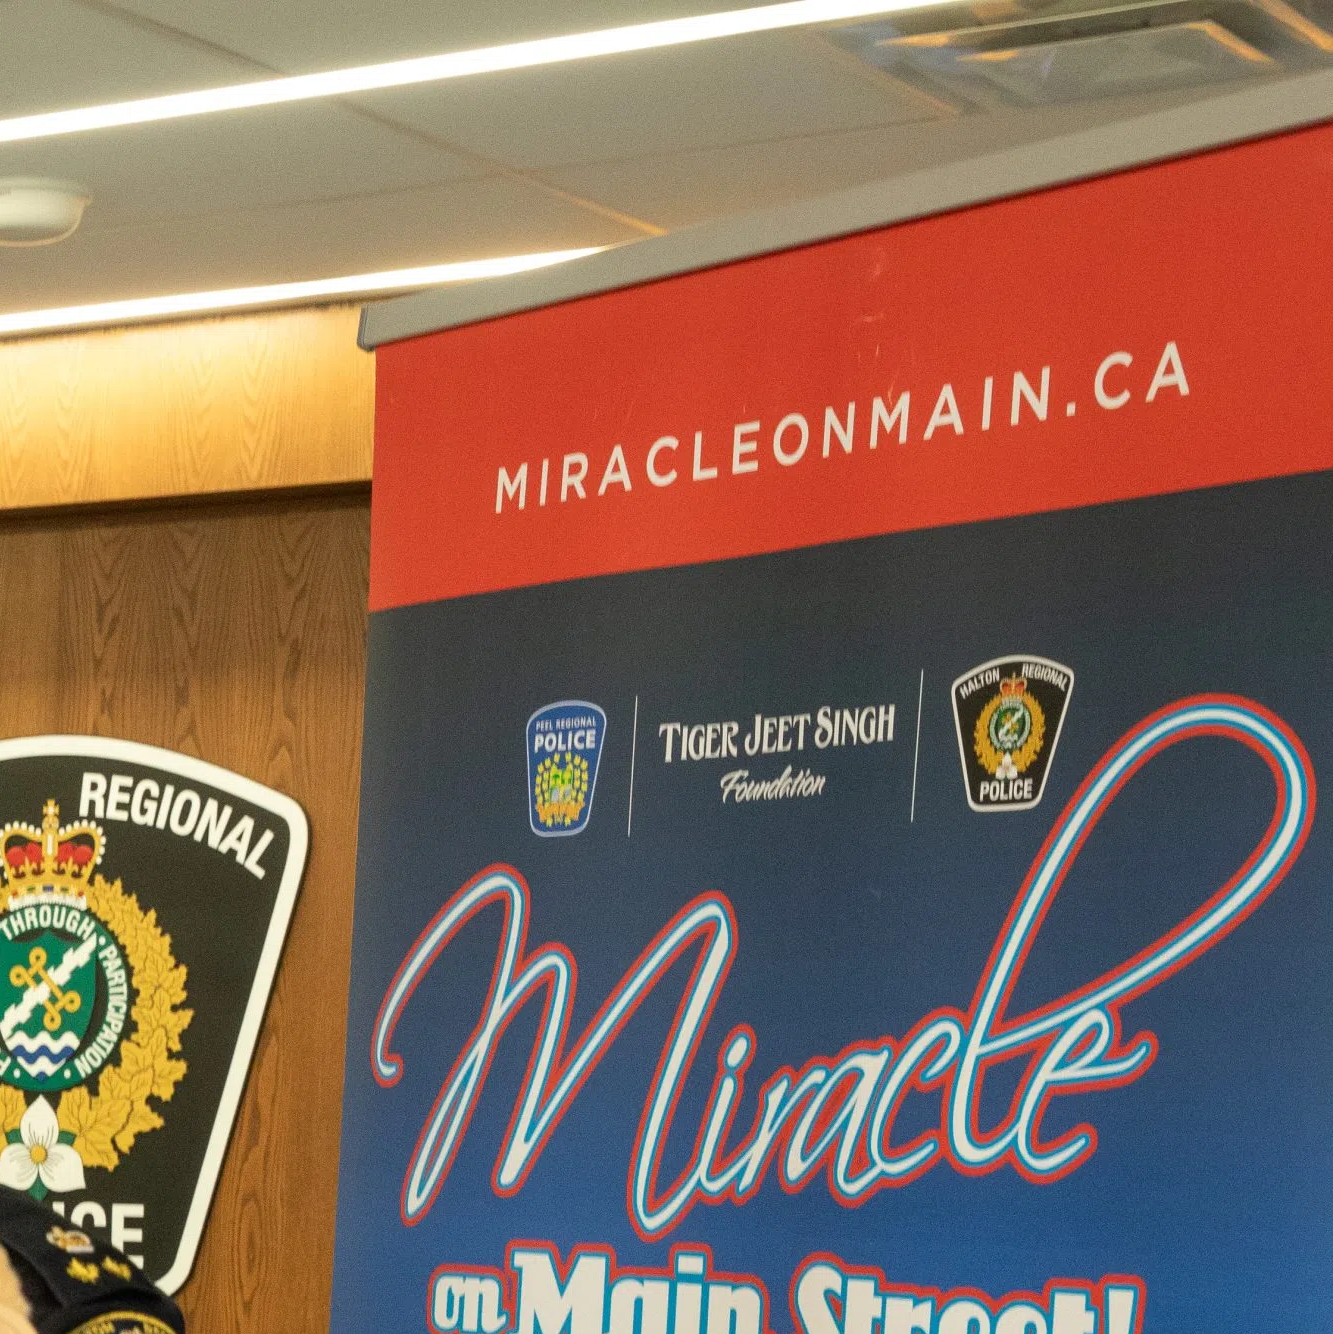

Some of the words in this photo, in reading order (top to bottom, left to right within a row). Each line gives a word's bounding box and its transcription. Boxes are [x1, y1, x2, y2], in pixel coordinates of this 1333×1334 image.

[495, 341, 1191, 514] MIRACLEONMAIN.CA
[959, 667, 1000, 699] HALTON
[1022, 663, 1068, 692] REGIONAL
[534, 729, 597, 753] POLICE
[535, 719, 553, 732] PEEL
[555, 716, 597, 730] REGIONAL
[659, 720, 738, 763] TIGER
[744, 714, 812, 756] JEET
[814, 704, 895, 749] SINGH
[721, 764, 827, 804] Foundation
[979, 778, 1033, 802] POLICE
[78, 772, 276, 880] REGIONAL
[373, 693, 1315, 1239] Miracle
[74, 946, 126, 1079] PARTICIPATION
